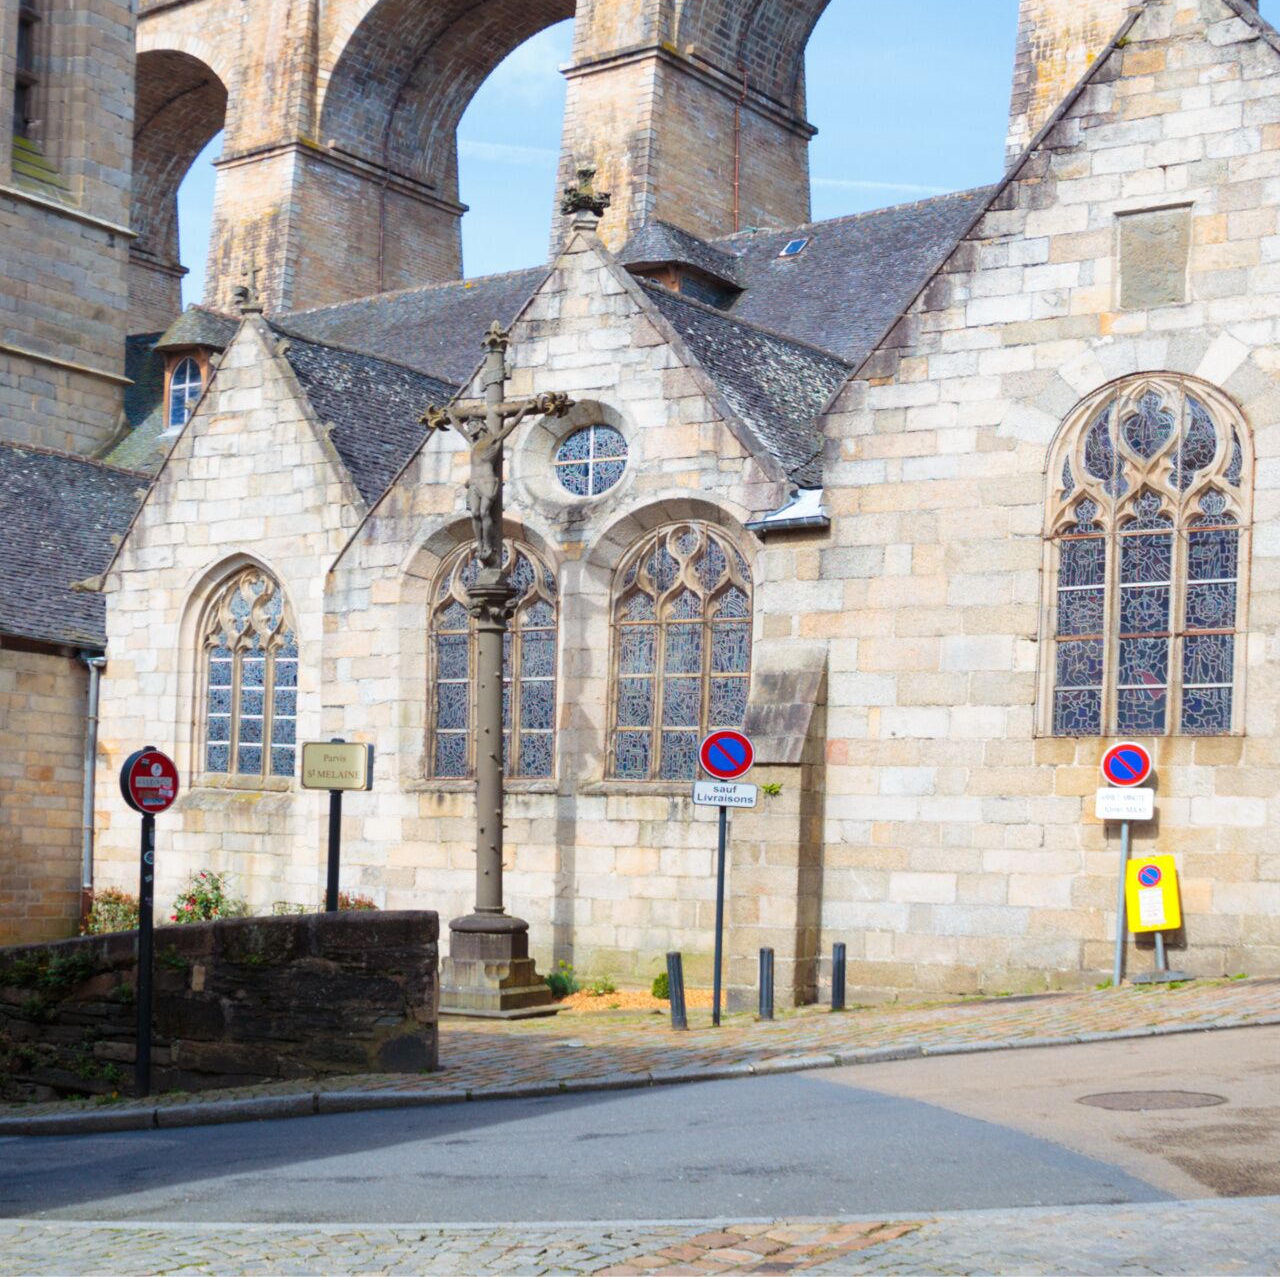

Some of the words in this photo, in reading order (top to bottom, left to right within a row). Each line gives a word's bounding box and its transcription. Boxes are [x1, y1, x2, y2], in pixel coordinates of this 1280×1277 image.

[323, 753, 347, 763] Parvis
[317, 770, 361, 780] MELAINE
[713, 785, 737, 794] sauf
[697, 793, 754, 804] Livraisons
